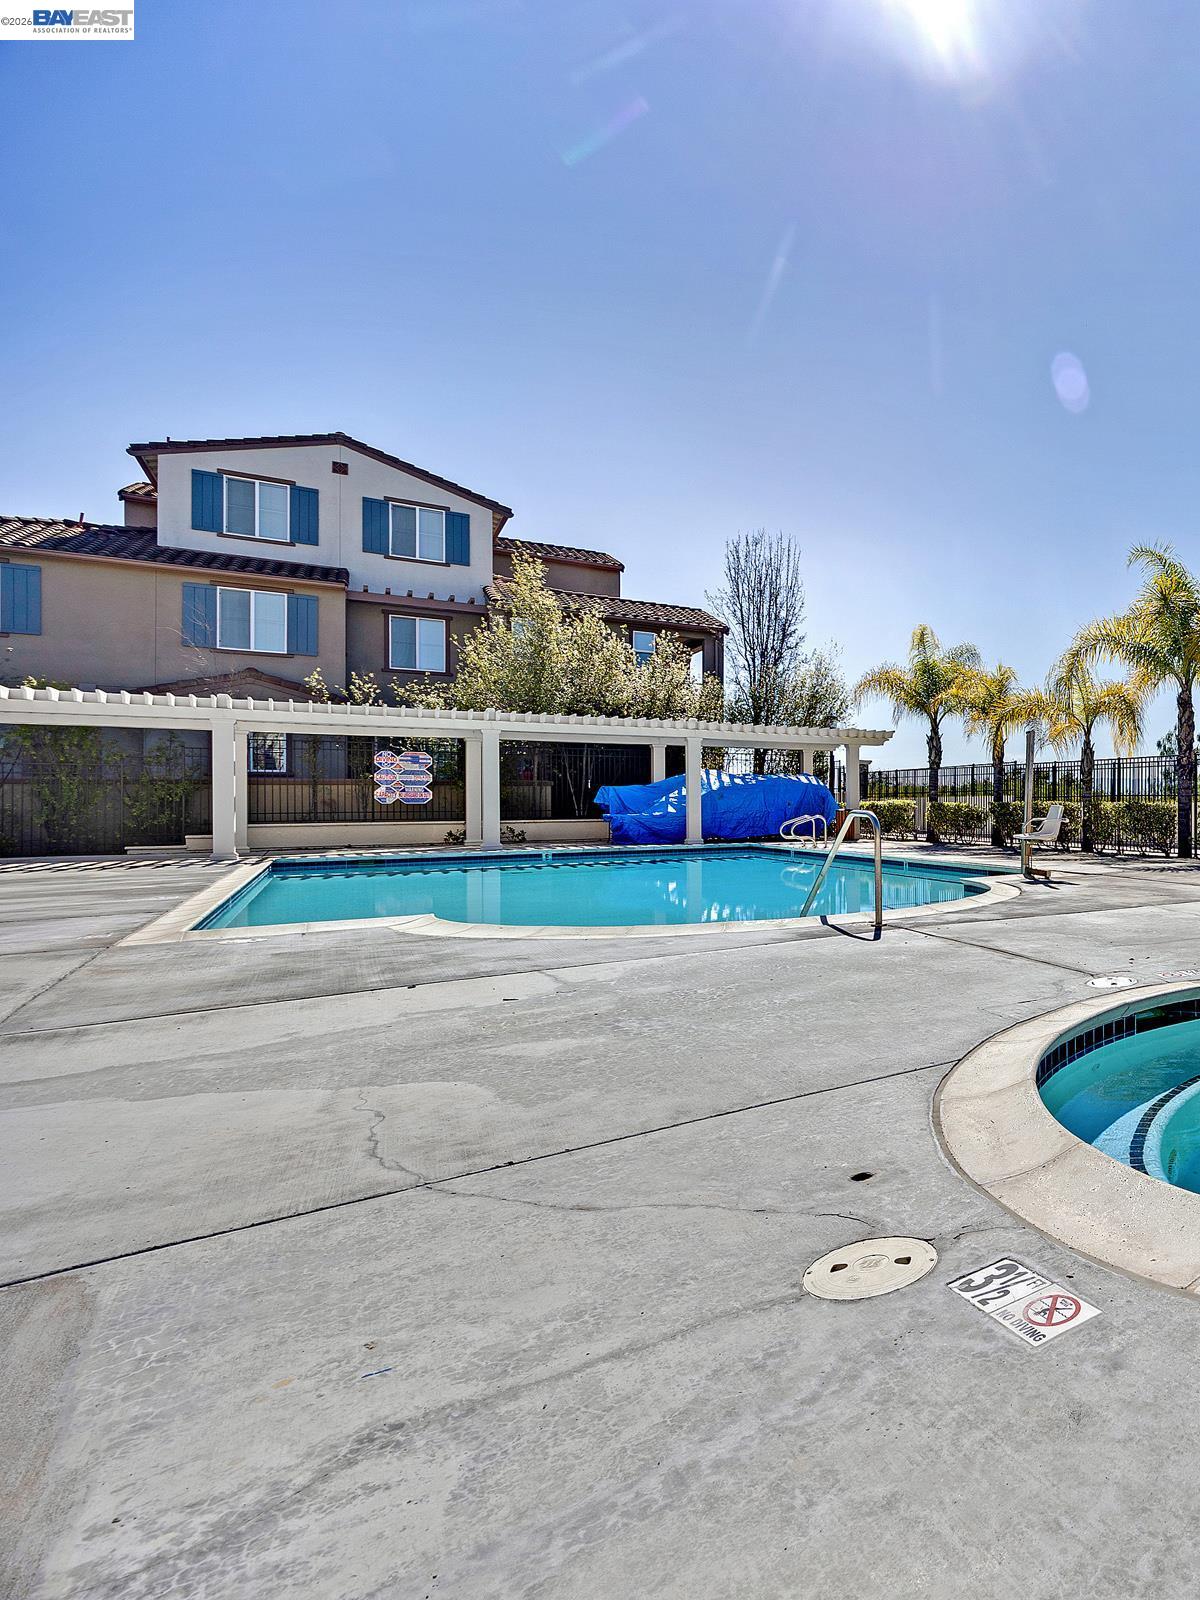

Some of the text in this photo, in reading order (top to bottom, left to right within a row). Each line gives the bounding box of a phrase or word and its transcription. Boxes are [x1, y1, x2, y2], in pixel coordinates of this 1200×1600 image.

[1026, 1278, 1049, 1289] FT
[996, 1309, 1047, 1342] NO DIVING
